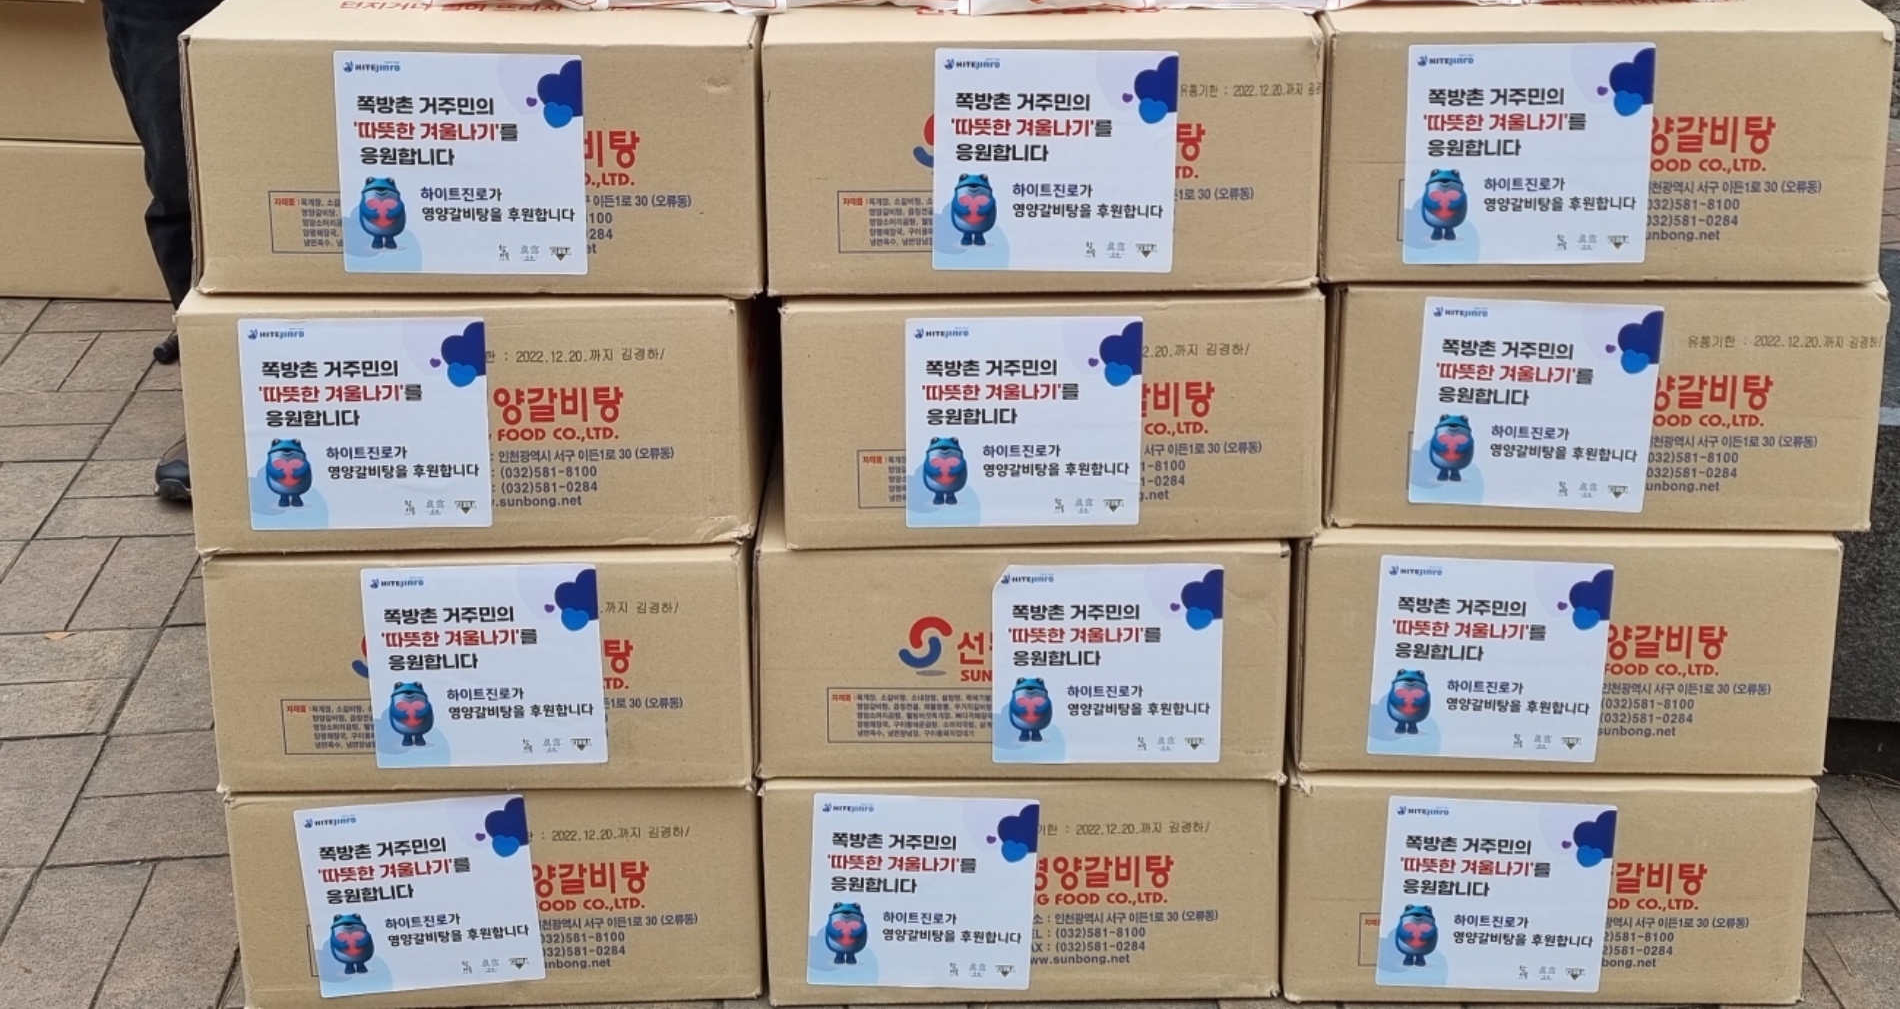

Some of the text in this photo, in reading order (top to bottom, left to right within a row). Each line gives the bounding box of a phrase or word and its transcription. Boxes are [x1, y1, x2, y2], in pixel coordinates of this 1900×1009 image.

[357, 95, 494, 116] 쪽방촌 거주민의
[955, 92, 1091, 112] 쪽방촌 거주민의
[1428, 87, 1565, 107] 쪽방촌 거주민의
[360, 146, 456, 166] 응원합니다
[955, 143, 1049, 162] 응원합니다
[1427, 138, 1522, 158] 응원합니다
[1698, 158, 1766, 174] CO.,LTD.
[1012, 182, 1094, 199] 하이트진로가
[1484, 177, 1566, 192] 하이트진로가
[420, 186, 503, 203] 하이트진로가
[1012, 203, 1164, 220] 영양갈비탕을 후원합니다
[1483, 196, 1637, 213] 영양갈비탕을 후원합니다
[421, 206, 576, 223] 영양갈비탕을 후원합니다
[1442, 338, 1574, 361] 쪽방촌 거주민의
[261, 359, 399, 379] 쪽방촌 거주민의
[925, 359, 1058, 378] 쪽방촌 거주민의
[1438, 386, 1530, 406] 응원합니다
[265, 409, 361, 428] 응원합니다
[926, 407, 1018, 426] 응원합니다
[1699, 414, 1764, 428] CO.,LTD.
[498, 427, 619, 442] FOOD CO.,LTD.
[1144, 422, 1208, 436] CO.,LTD.
[1491, 424, 1570, 441] 하이트진로가
[325, 445, 408, 461] 하이트진로가
[499, 449, 550, 463] 인천광역시
[554, 449, 575, 462] 서구
[619, 449, 631, 459] 30
[982, 444, 1062, 459] 하이트진로가
[1489, 443, 1638, 463] 영양갈비탕을 후원합니다
[327, 463, 480, 480] 영양갈비탕을 후원합니다
[501, 466, 597, 479] (032)581-8100
[982, 462, 1130, 478] 영양갈비탕을 후원합니다
[501, 482, 598, 494] (032)581-0284
[383, 605, 515, 626] 쪽방촌 거주민의
[1012, 603, 1140, 621] 쪽방촌 거주민의
[1398, 596, 1527, 618] 쪽방촌 거주민의
[1012, 650, 1102, 667] 응원합니다
[1395, 641, 1484, 662] 응원합니다
[388, 652, 479, 672] 응원합니다
[1656, 663, 1719, 678] CO.,LTD.
[446, 687, 525, 702] 하이트진로가
[1066, 685, 1144, 699] 하이트진로가
[1446, 679, 1524, 695] 하이트진로가
[448, 703, 594, 721] 영양갈비탕을 후원합니다
[1067, 701, 1211, 717] 영양갈비탕을 후원합니다
[1446, 697, 1591, 716] 영양갈비탕을 후원합니다
[319, 836, 447, 862] 쪽방촌 거주민의
[832, 832, 957, 851] 쪽방촌 거주민의
[1405, 834, 1532, 856] 쪽방촌 거주민의
[831, 875, 918, 894] 응원합니다
[1402, 878, 1490, 898] 응원합니다
[326, 883, 414, 905] 응원합니다
[1055, 892, 1168, 905] FOOD CO.,LTD.
[583, 898, 645, 912] CO.,LTD.
[1637, 898, 1698, 911] CO.,LTD.
[384, 912, 461, 931] 하이트진로가
[882, 910, 958, 926] 하이트진로가
[1055, 912, 1104, 925] 인천광역시
[1107, 912, 1126, 924] 서구
[1167, 911, 1178, 921] 30
[1453, 913, 1530, 929] 하이트진로가
[387, 923, 529, 948] 영양갈비탕을 후원합니다
[882, 928, 1022, 944] 영양갈비탕을 후원합니다
[1056, 927, 1146, 939] (032)581-8100
[1452, 930, 1594, 949] 영양갈비탕을 후원합니다
[1056, 941, 1145, 952] (032)581-0284
